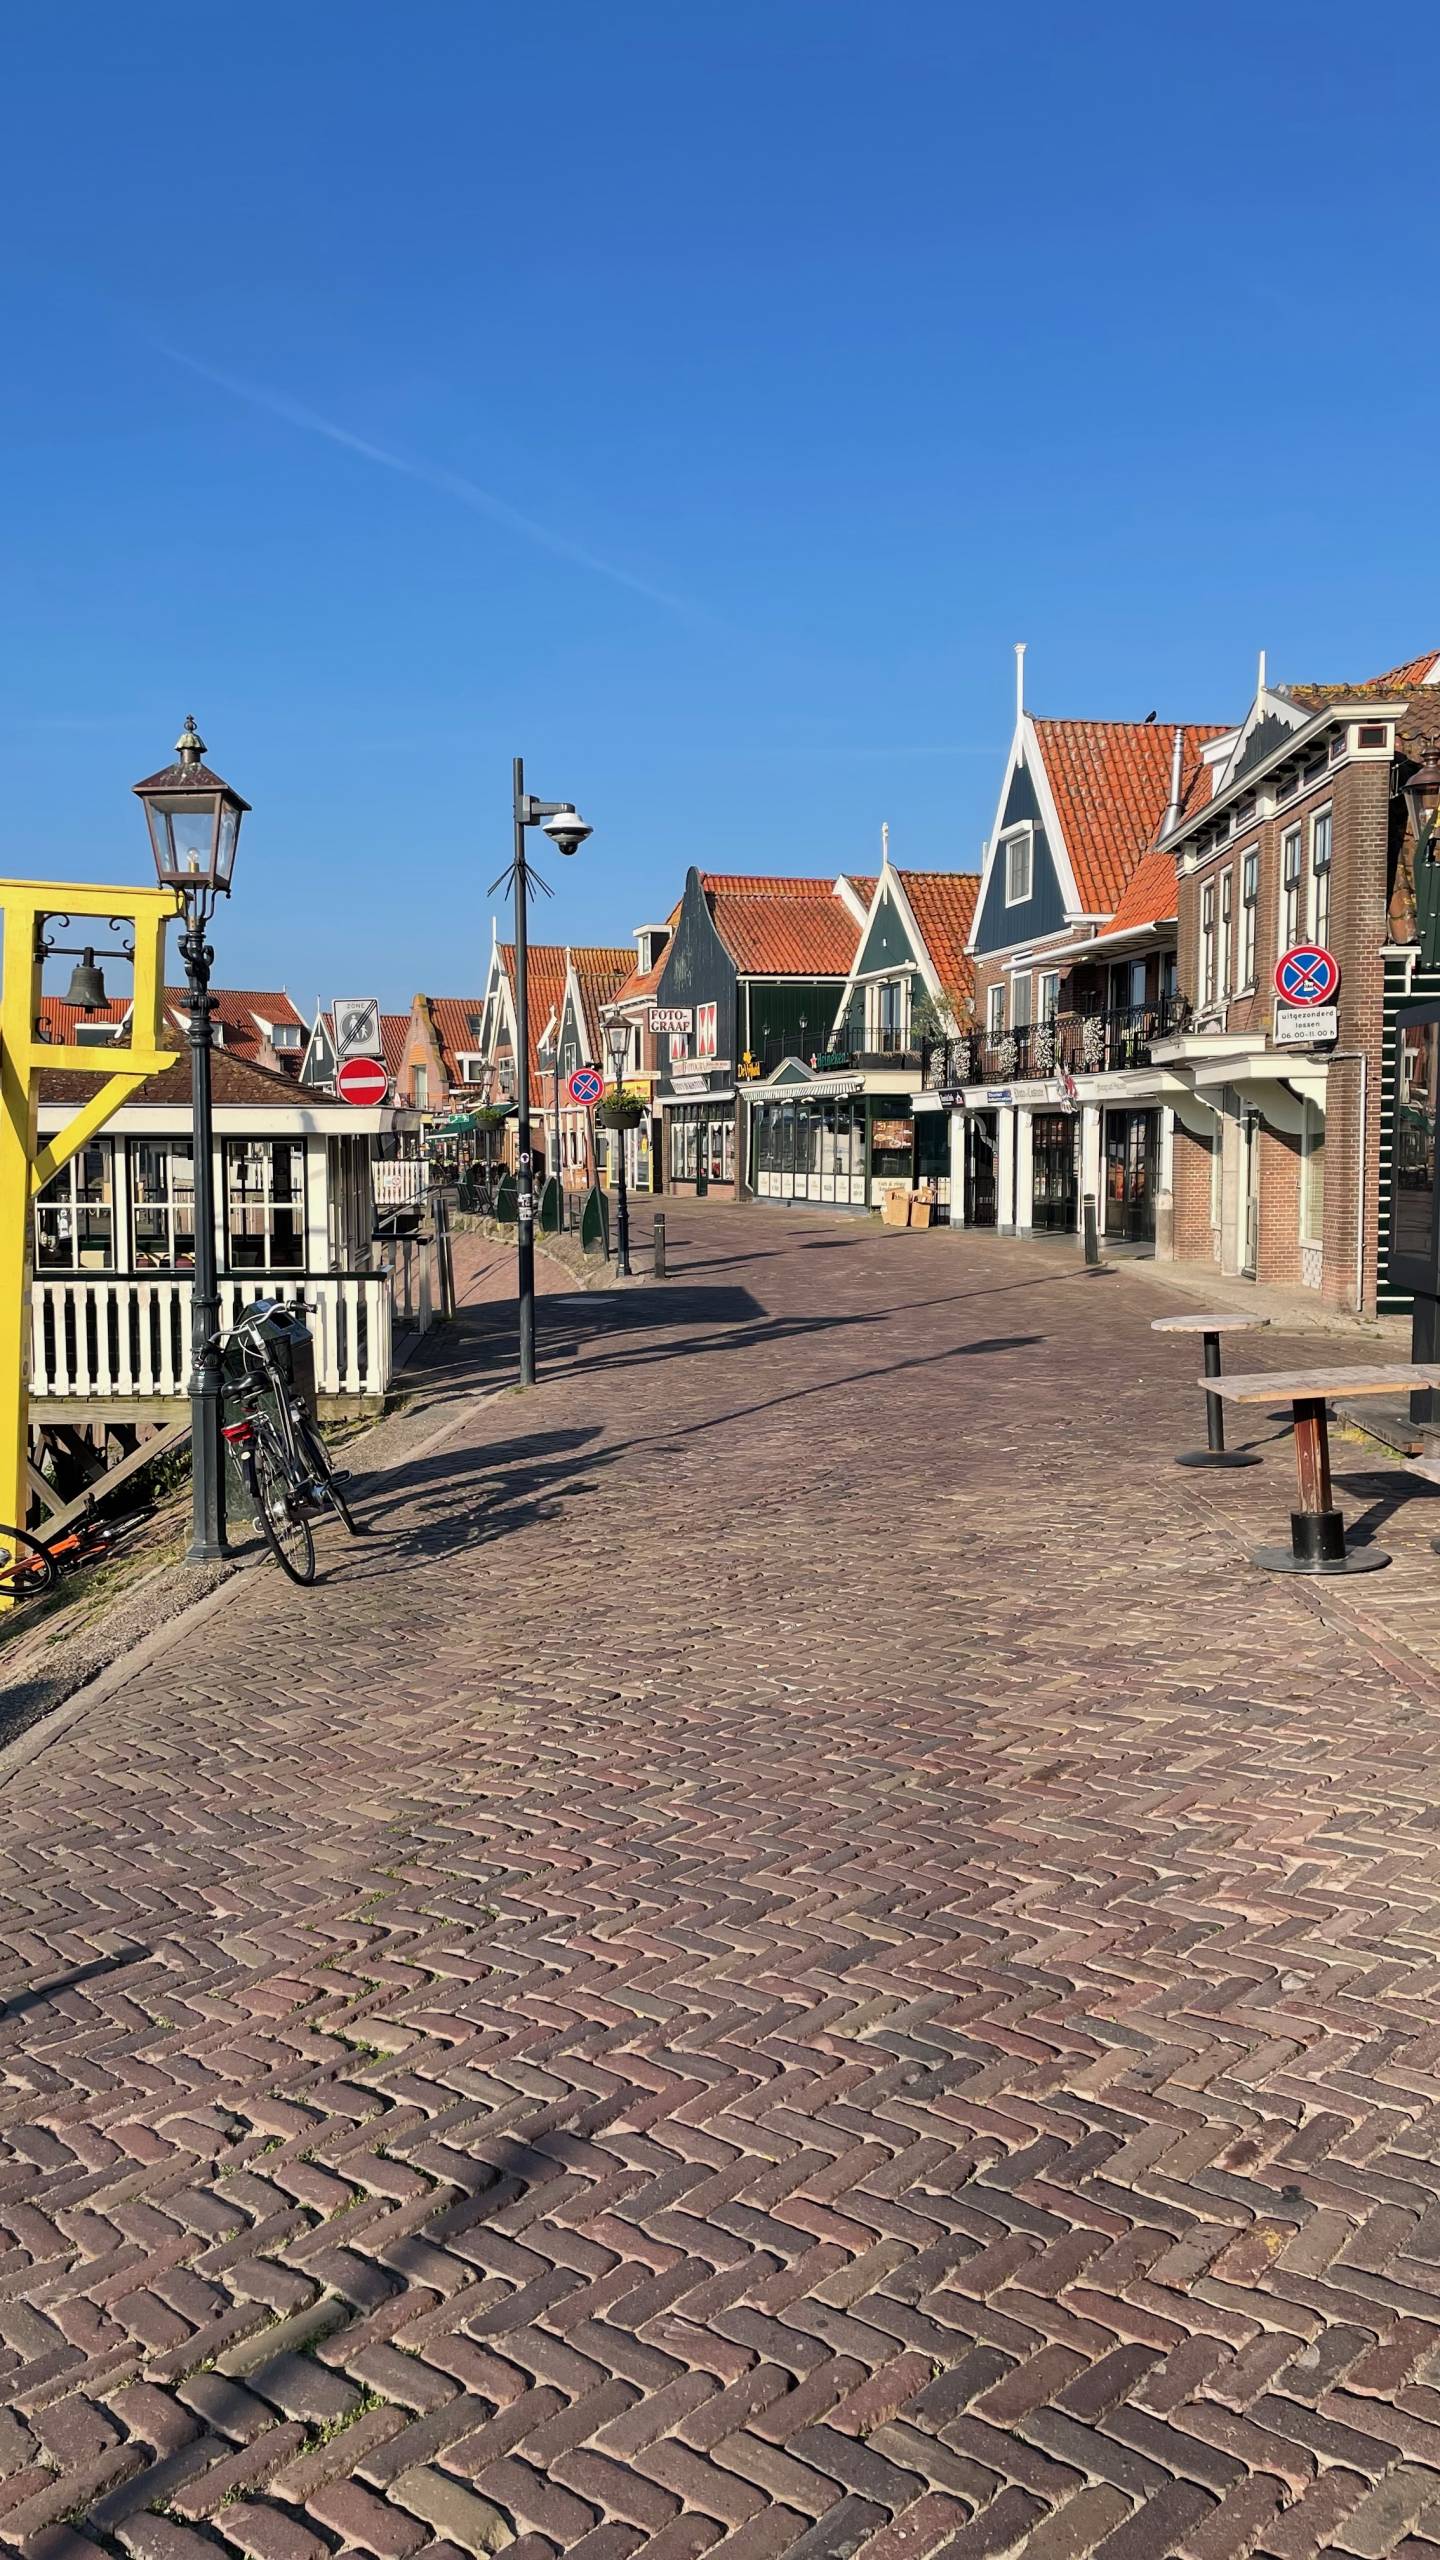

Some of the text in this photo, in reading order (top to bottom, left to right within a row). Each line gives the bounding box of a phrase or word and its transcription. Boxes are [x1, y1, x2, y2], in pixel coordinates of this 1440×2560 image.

[651, 1010, 687, 1020] FOTO-
[1281, 1011, 1334, 1020] uitgezonderd
[651, 1021, 690, 1031] GRAAF
[817, 1052, 846, 1067] Heineken
